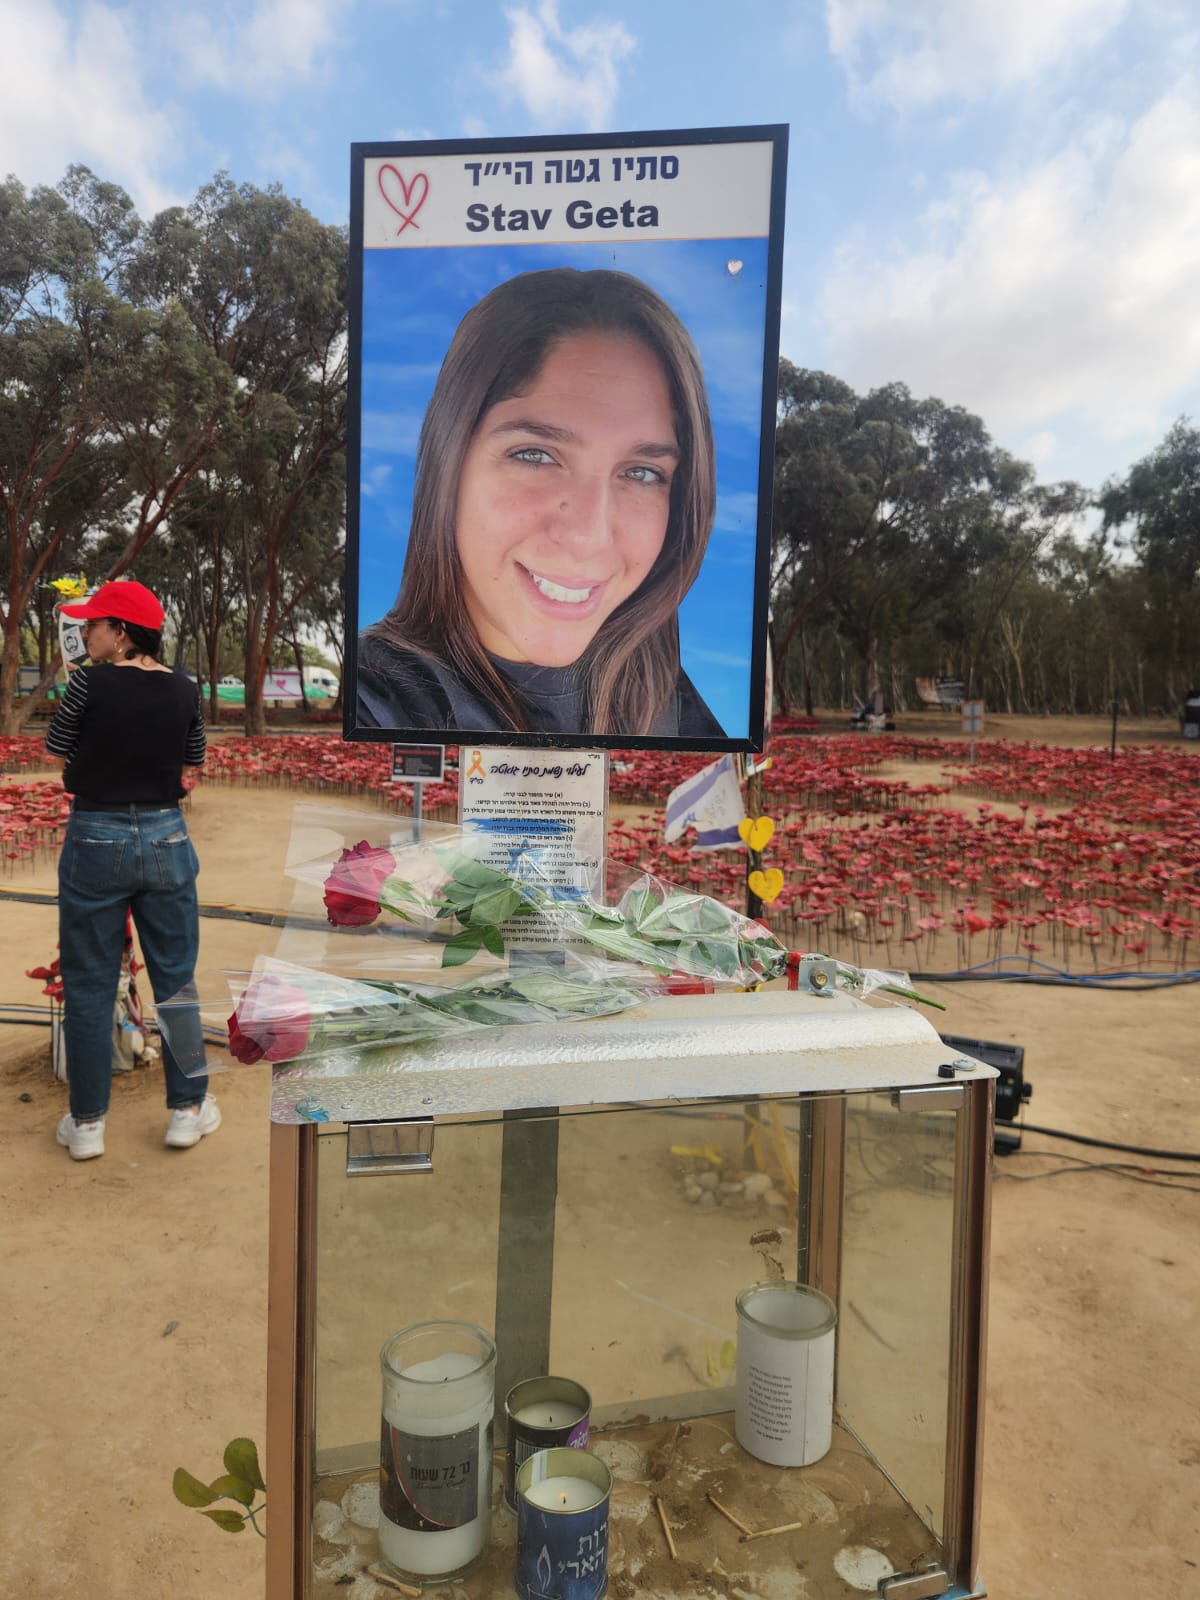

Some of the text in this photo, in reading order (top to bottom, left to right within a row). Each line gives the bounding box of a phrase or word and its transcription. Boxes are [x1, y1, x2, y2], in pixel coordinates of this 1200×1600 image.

[544, 158, 600, 184] גטה
[612, 155, 679, 181] סתיו
[465, 200, 659, 232] Stav Geta
[522, 766, 540, 777] סתיו
[442, 1466, 456, 1481] 72
